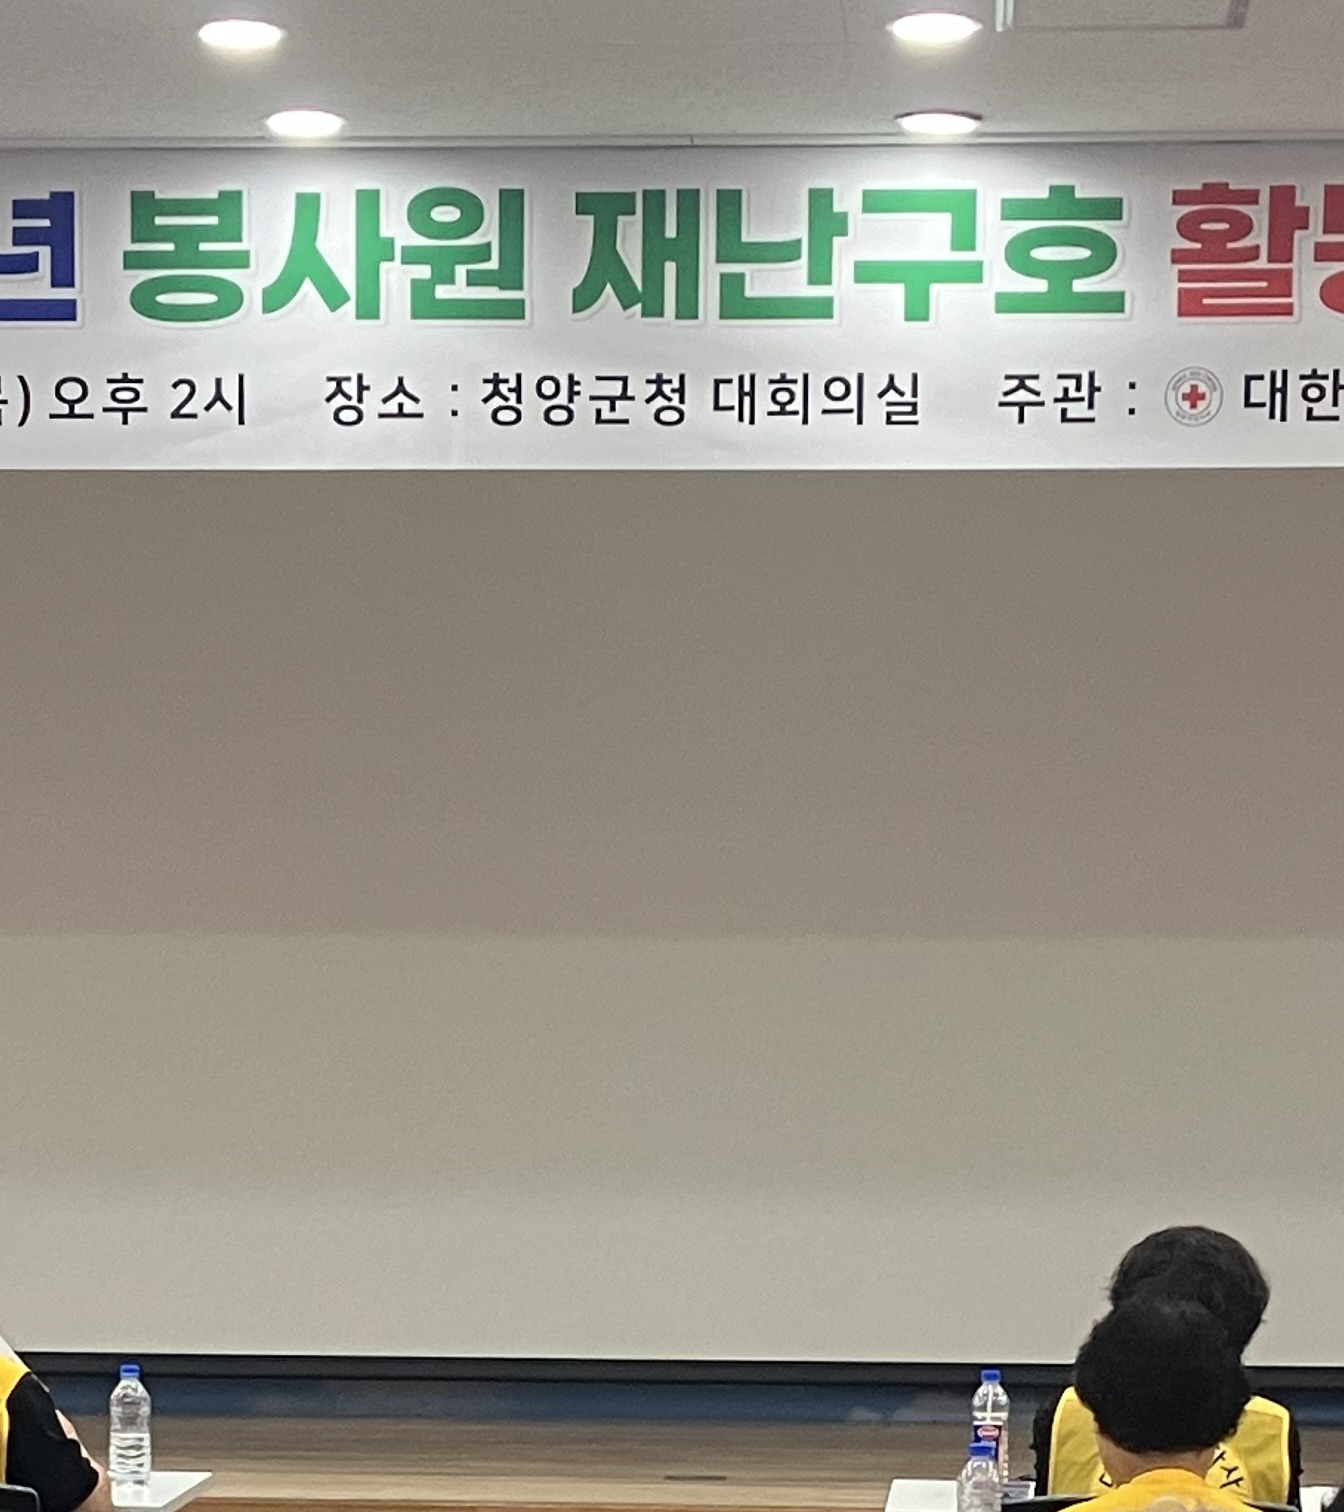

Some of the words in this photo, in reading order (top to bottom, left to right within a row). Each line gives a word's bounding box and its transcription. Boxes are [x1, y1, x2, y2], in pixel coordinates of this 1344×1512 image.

[122, 187, 526, 322] 봉사원
[571, 184, 1126, 322] 재난구호
[48, 372, 148, 426] 오후
[170, 373, 246, 426] 2시
[324, 372, 425, 427] 장소
[481, 372, 687, 427] 청양군청
[712, 372, 920, 426] 대회의실
[997, 370, 1102, 425] 주관
